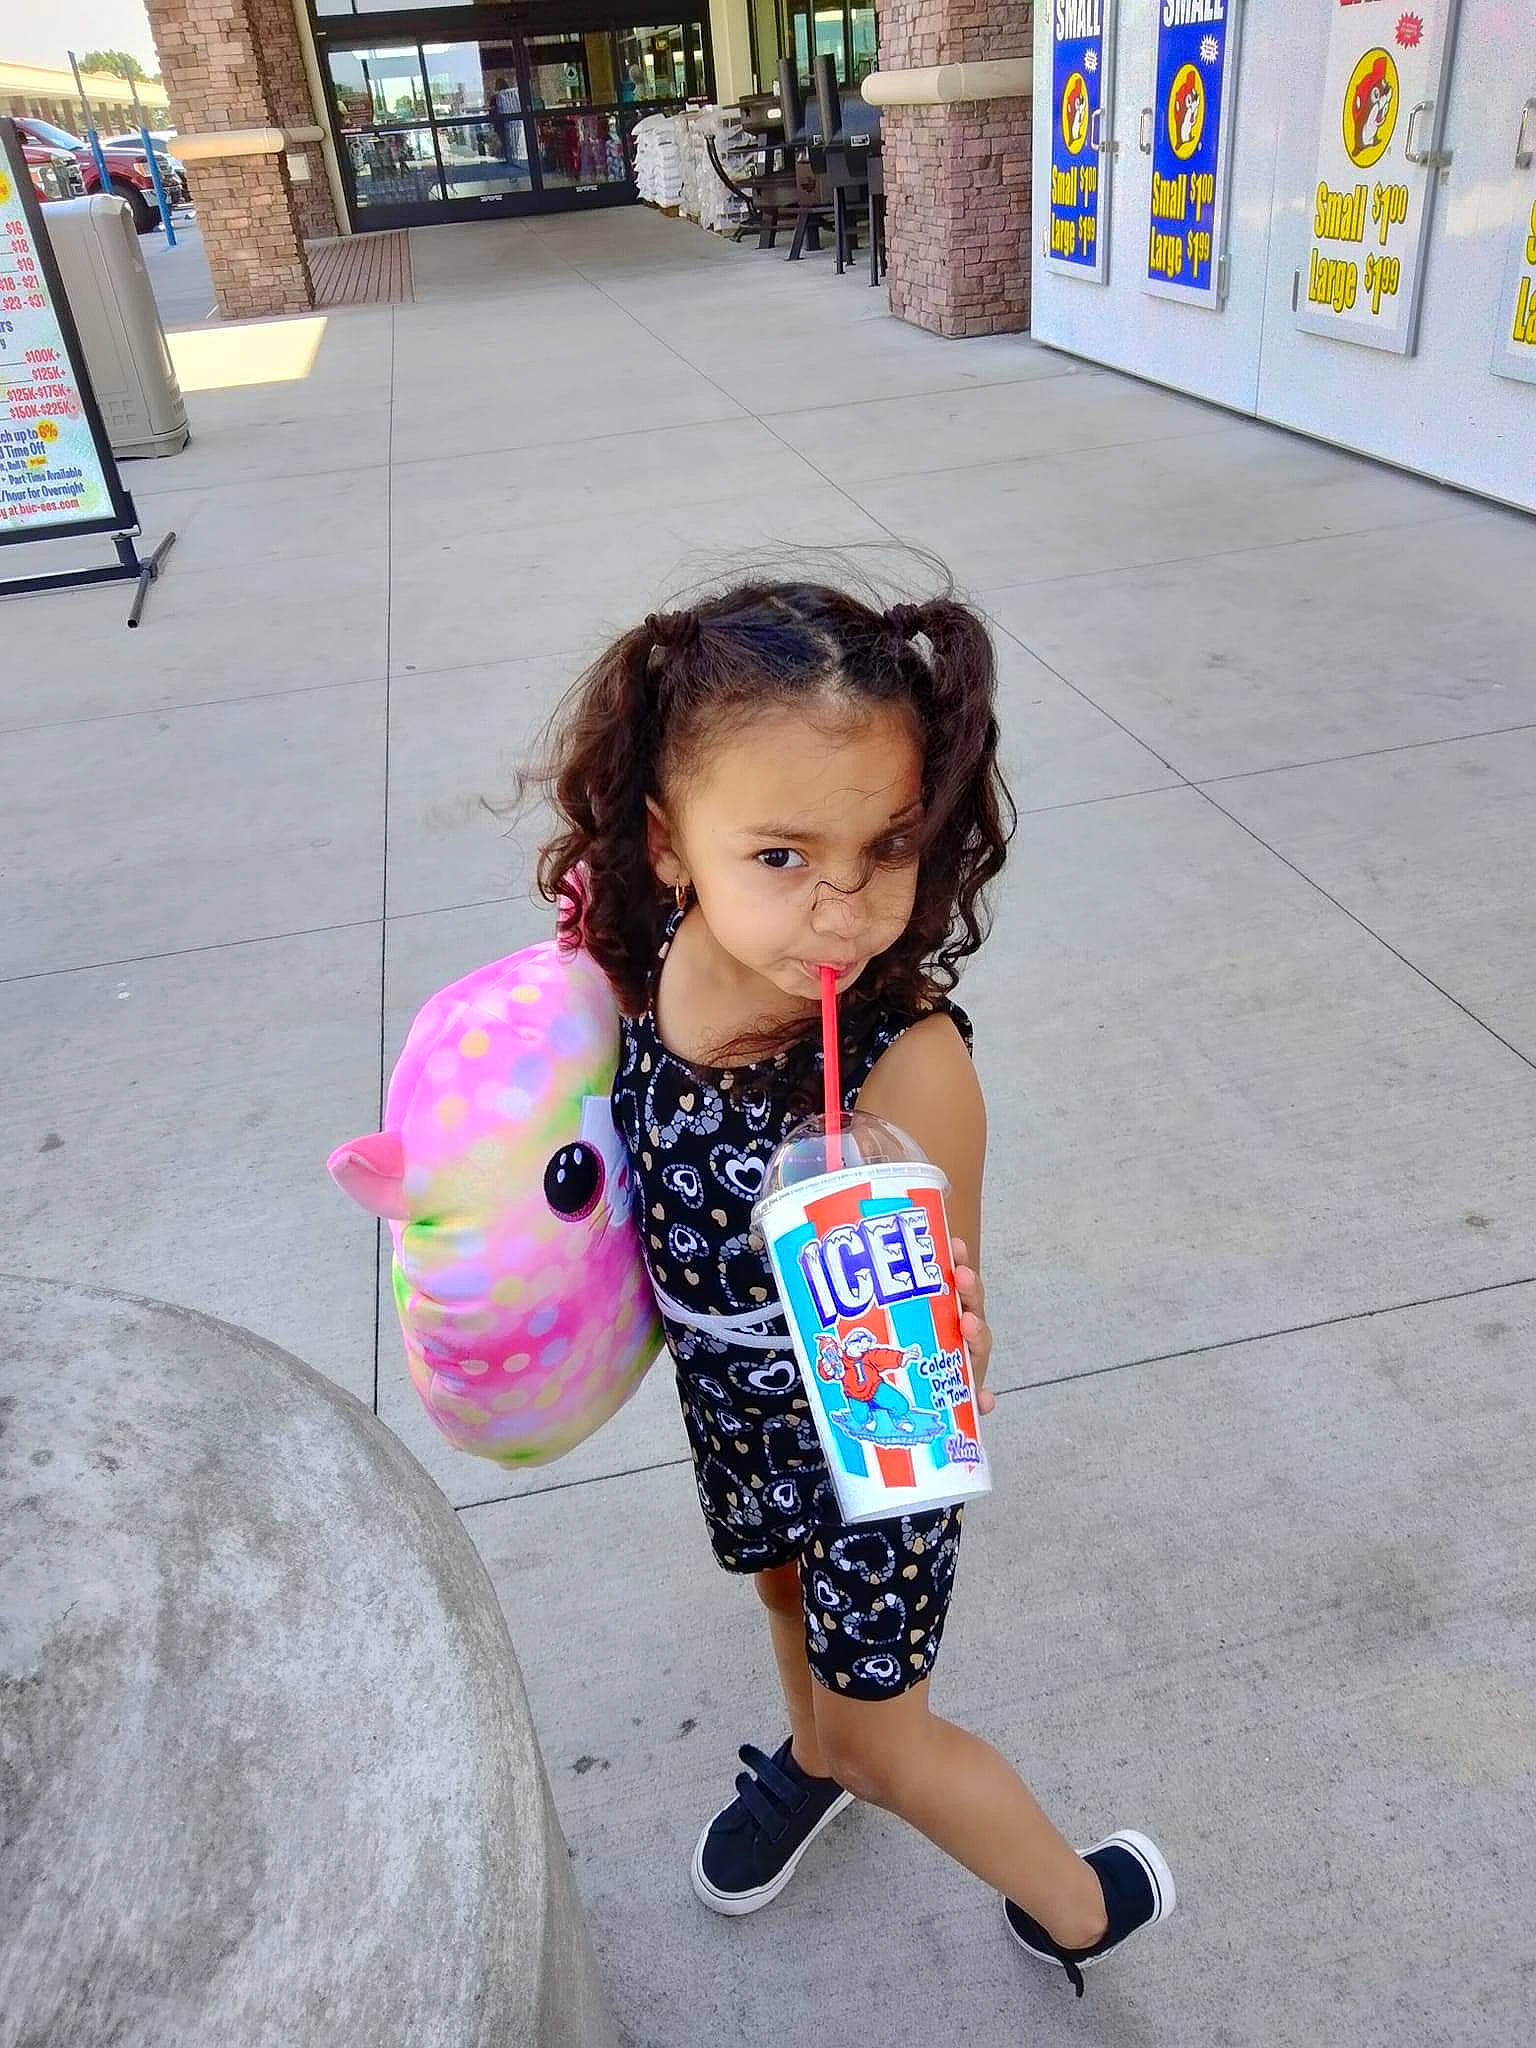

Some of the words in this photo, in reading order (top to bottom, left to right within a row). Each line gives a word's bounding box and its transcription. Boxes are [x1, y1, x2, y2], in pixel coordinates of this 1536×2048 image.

[1056, 0, 1100, 41] SMALL
[1051, 164, 1077, 207] Small
[1152, 171, 1187, 220] Small
[1314, 181, 1368, 243] Small
[1051, 212, 1075, 257] Large
[1151, 226, 1183, 278] Large
[1308, 247, 1358, 313] Large
[4, 445, 29, 458] Time
[30, 441, 46, 455] Off
[27, 487, 41, 499] for
[42, 482, 85, 498] Overnight
[47, 467, 82, 481] Available
[19, 498, 79, 515] buc-ees.com
[799, 1209, 943, 1328] ICEE
[920, 1350, 961, 1376] Coldest
[932, 1368, 961, 1392] Drink
[932, 1395, 946, 1408] in
[947, 1388, 969, 1404] Town
